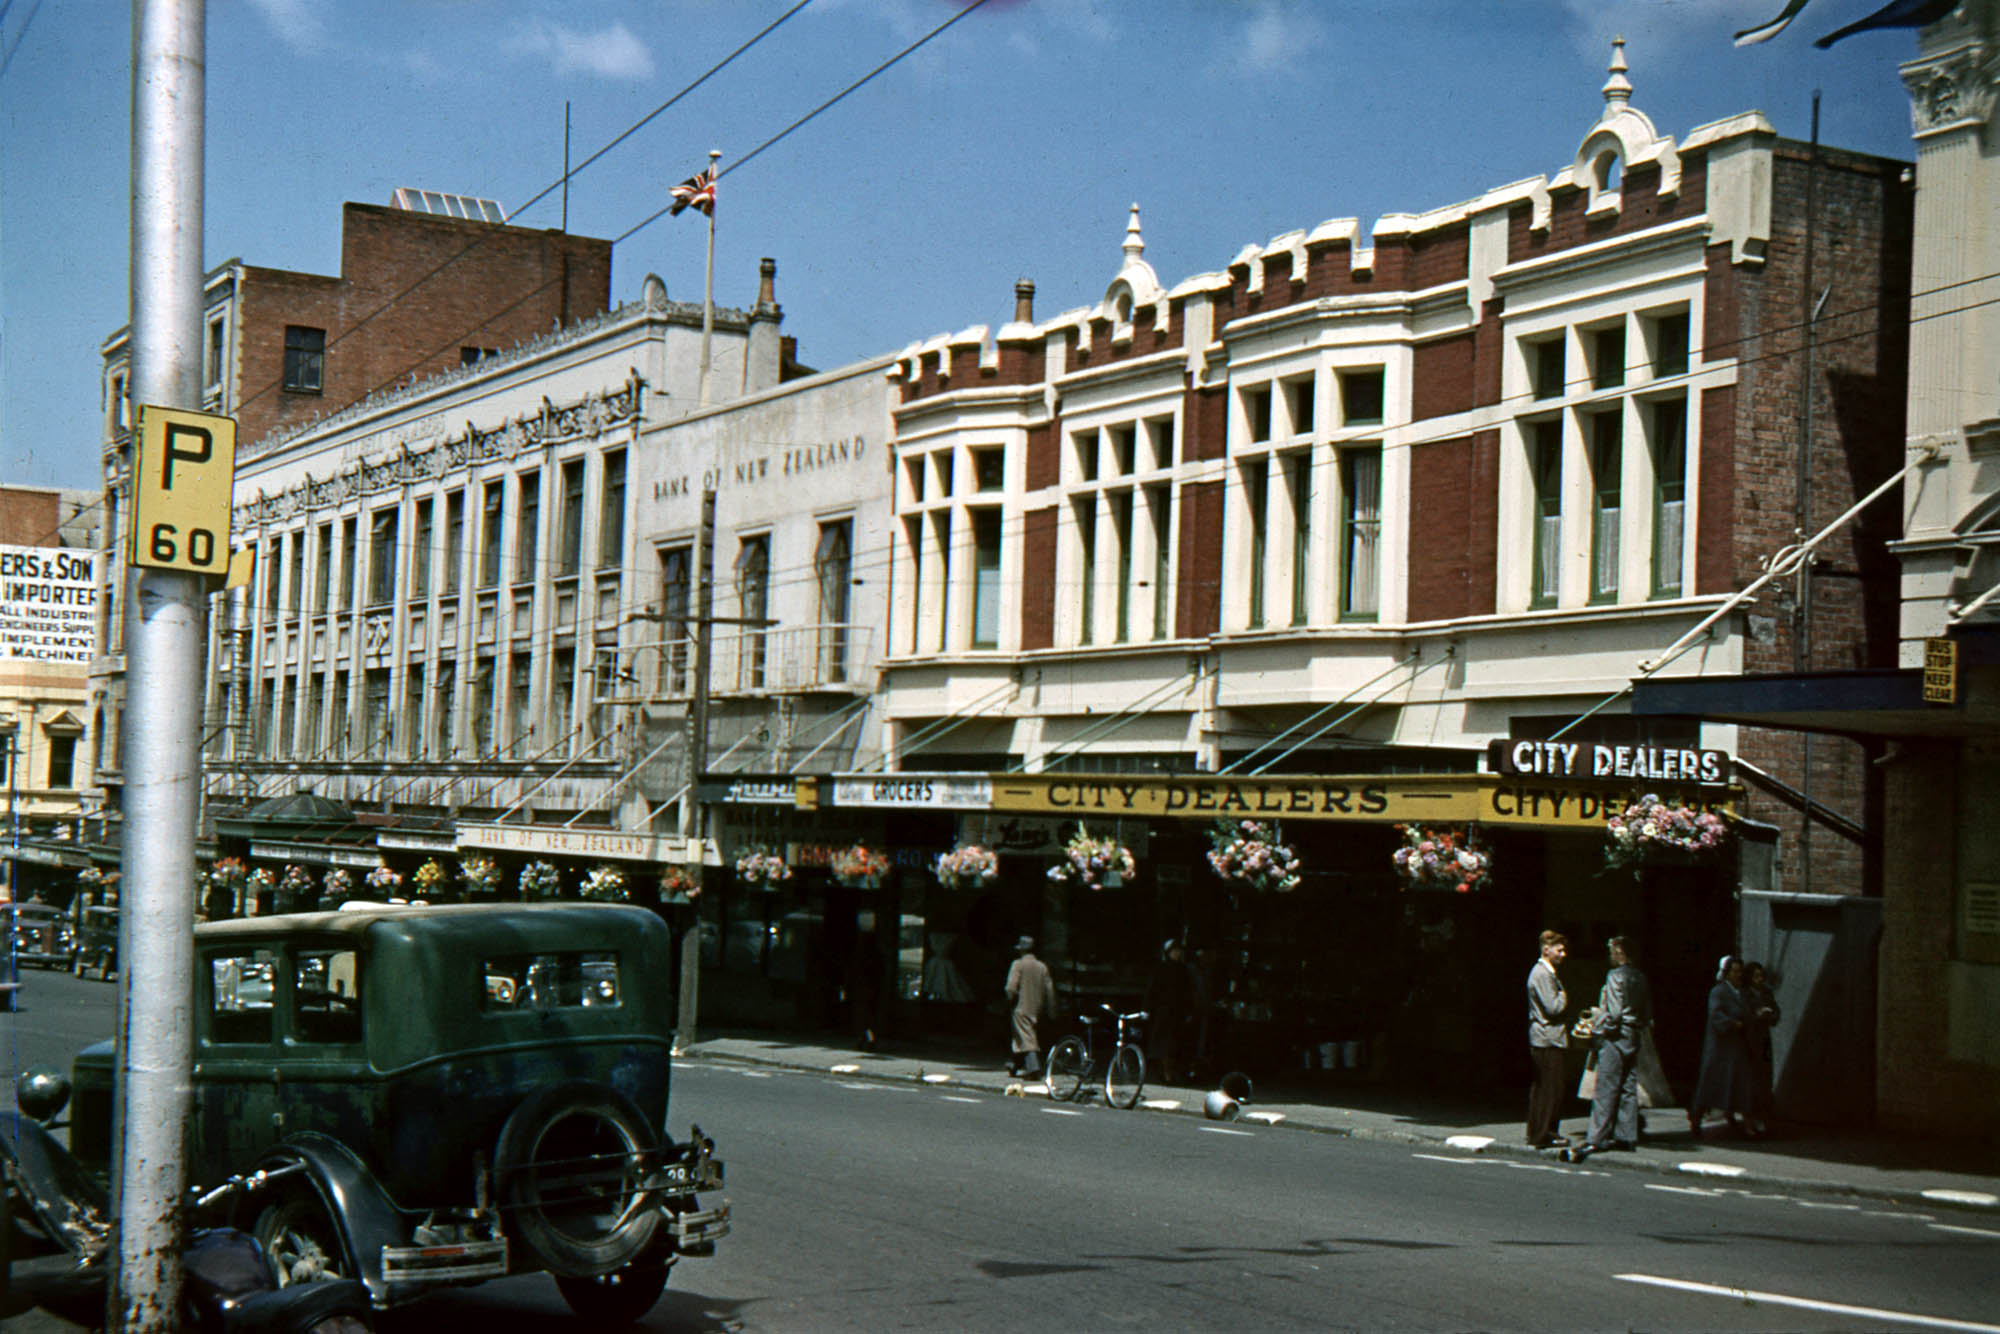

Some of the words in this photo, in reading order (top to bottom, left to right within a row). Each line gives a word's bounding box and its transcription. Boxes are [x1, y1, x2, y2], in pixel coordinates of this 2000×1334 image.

[160, 421, 213, 490] P
[653, 476, 688, 502] BANK
[703, 468, 721, 489] OF
[735, 457, 768, 485] NEW
[783, 434, 865, 477] ZEALAND
[150, 523, 214, 567] 60
[42, 561, 54, 578] &
[56, 553, 93, 582] SON
[1926, 654, 1952, 669] STOP
[1927, 639, 1951, 654] BUS
[1924, 686, 1952, 700] CLEAR
[1926, 671, 1951, 687] KEEP
[1512, 741, 1579, 775] CITY
[1593, 744, 1721, 782] DEALERS
[873, 780, 933, 801] GROCERS
[1047, 783, 1143, 808] CITY
[1163, 783, 1388, 814] DEALERS
[1492, 786, 1568, 818] CITY
